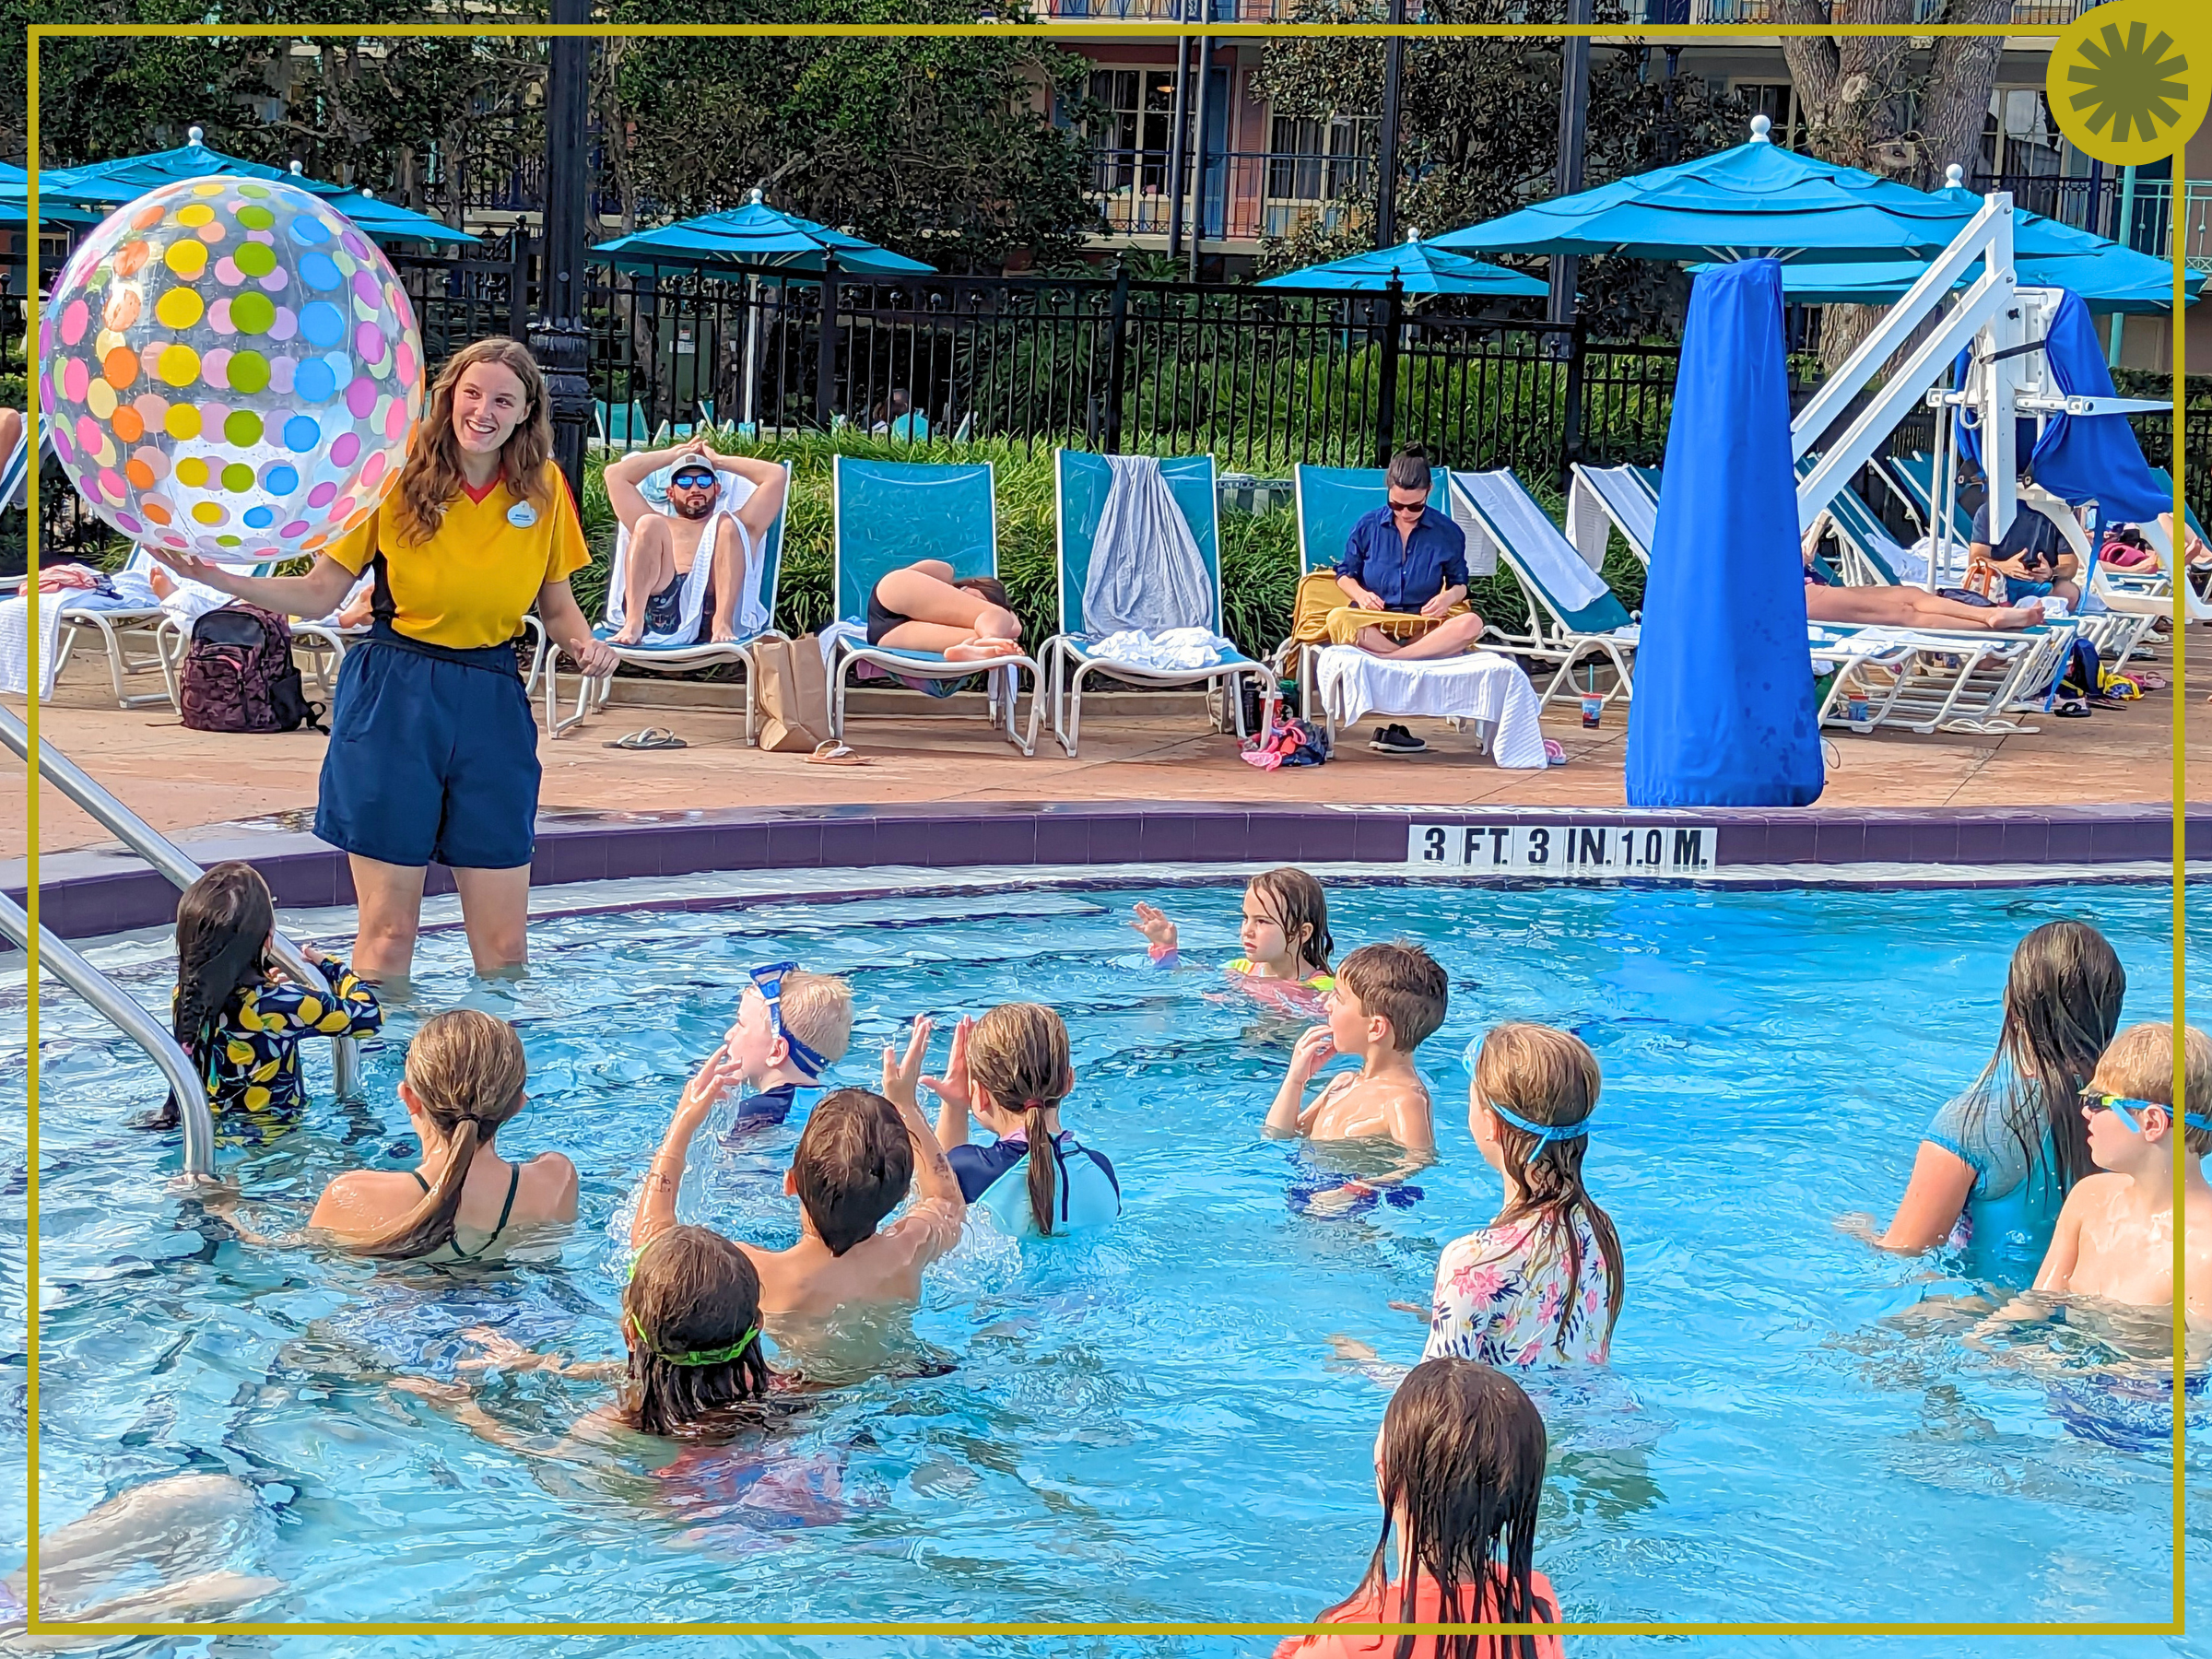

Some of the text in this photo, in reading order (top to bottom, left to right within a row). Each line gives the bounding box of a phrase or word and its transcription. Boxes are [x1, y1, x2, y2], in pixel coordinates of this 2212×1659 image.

[1423, 827, 1446, 862] 3
[1464, 828, 1510, 865] FT.
[1527, 828, 1550, 865] 3
[1567, 828, 1611, 865] IN.
[1674, 830, 1708, 866] M.
